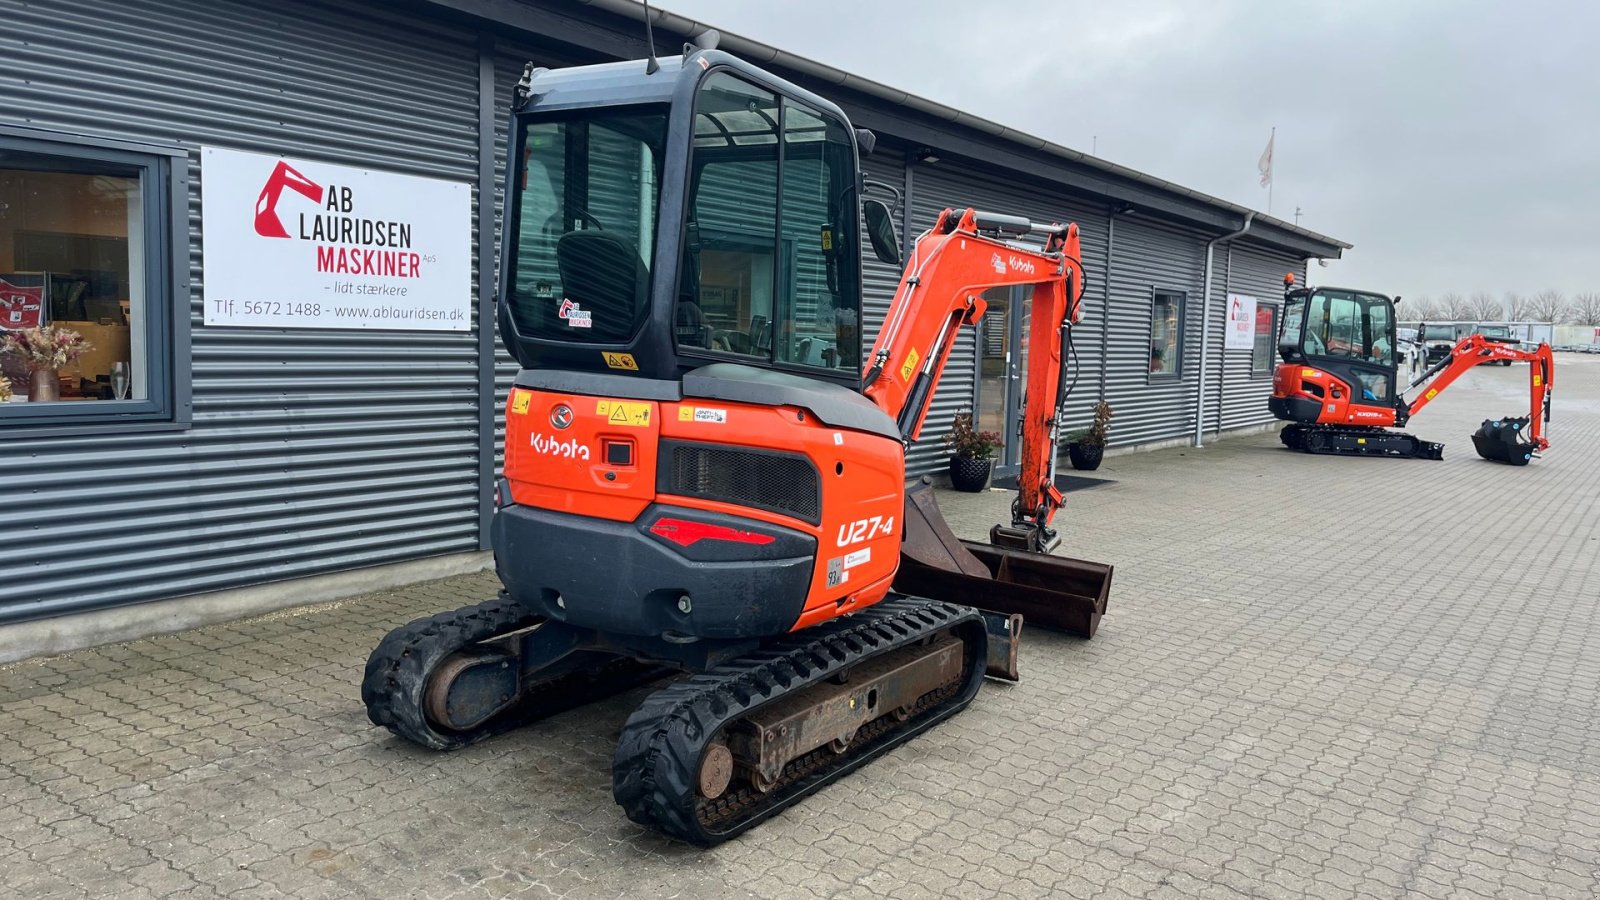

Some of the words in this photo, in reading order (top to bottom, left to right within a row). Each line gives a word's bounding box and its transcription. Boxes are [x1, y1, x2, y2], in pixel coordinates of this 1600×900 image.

[326, 185, 353, 213] AB
[299, 212, 411, 249] LAURIDSEN
[317, 245, 420, 278] MASKINER
[422, 254, 437, 263] ApS
[1009, 255, 1035, 275] Kubota
[334, 281, 354, 295] lidt
[356, 283, 408, 297] stærkere
[213, 299, 239, 317] Tlf.
[244, 301, 281, 315] 5672
[286, 302, 321, 317] 1488
[334, 305, 465, 321] www.ablauridsen.dk
[530, 431, 590, 461] Kubota
[836, 515, 894, 547] U27-4
